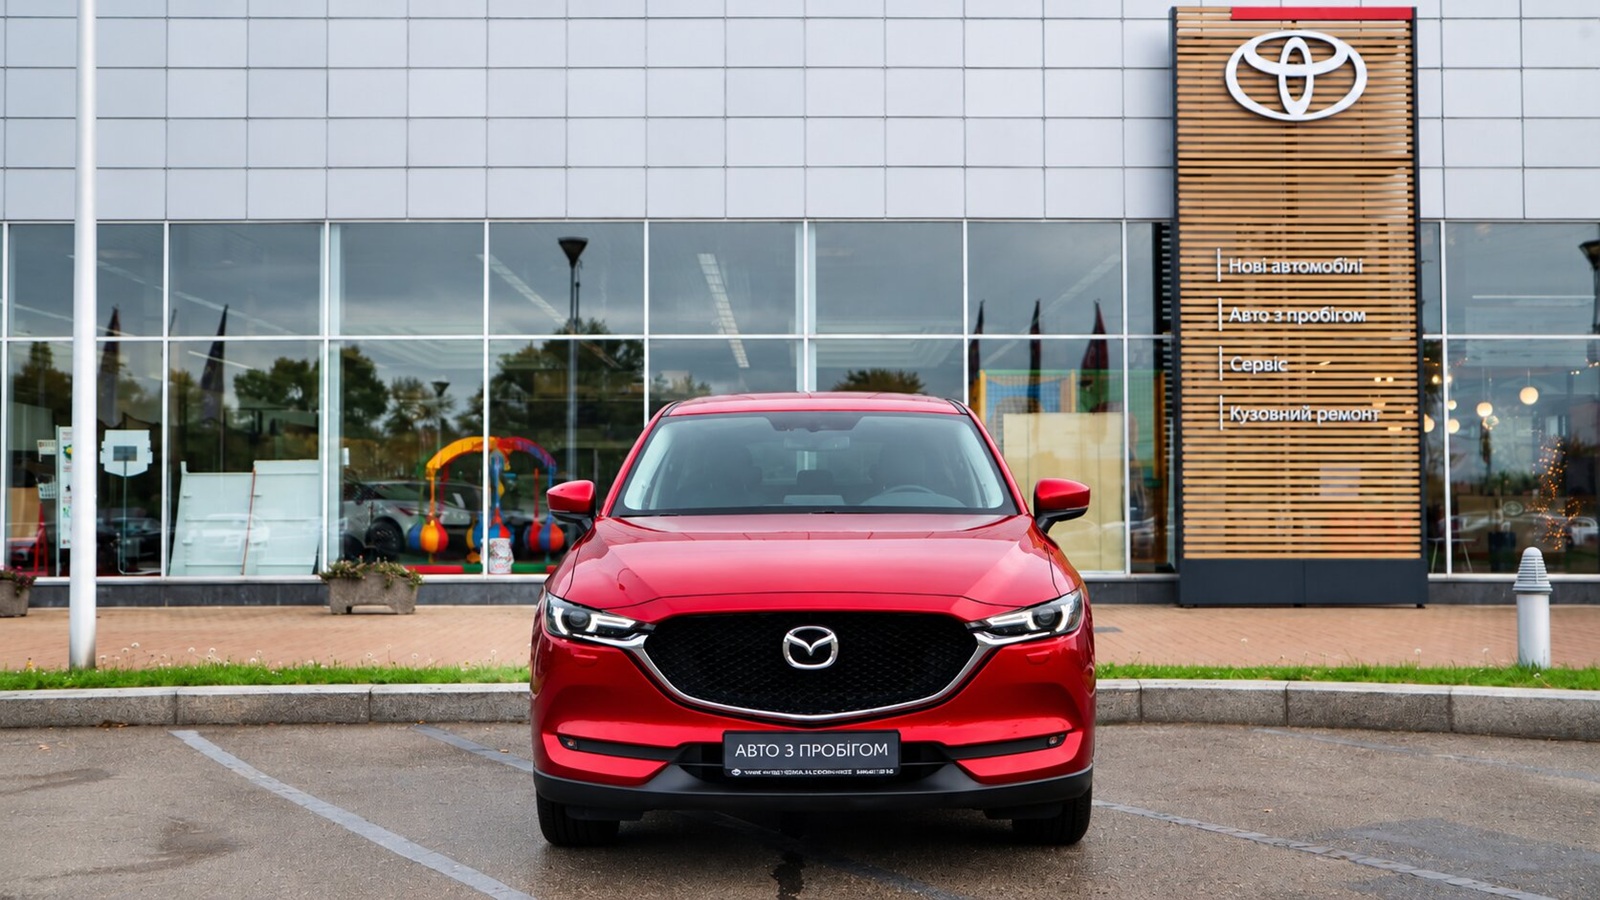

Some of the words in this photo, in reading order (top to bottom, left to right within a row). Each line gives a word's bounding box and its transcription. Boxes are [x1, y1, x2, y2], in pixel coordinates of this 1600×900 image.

[1229, 258, 1266, 273] Нові
[1271, 258, 1363, 273] автомобілі
[1229, 307, 1269, 322] Авто
[1274, 311, 1283, 322] з
[1287, 307, 1366, 324] пробігом
[1230, 356, 1288, 374] Сервіс
[1230, 405, 1312, 425] Кузовний
[1317, 409, 1381, 425] ремонт
[735, 744, 780, 757] АВТО
[784, 744, 794, 757] З
[800, 741, 888, 757] ПРОБІГОМ
